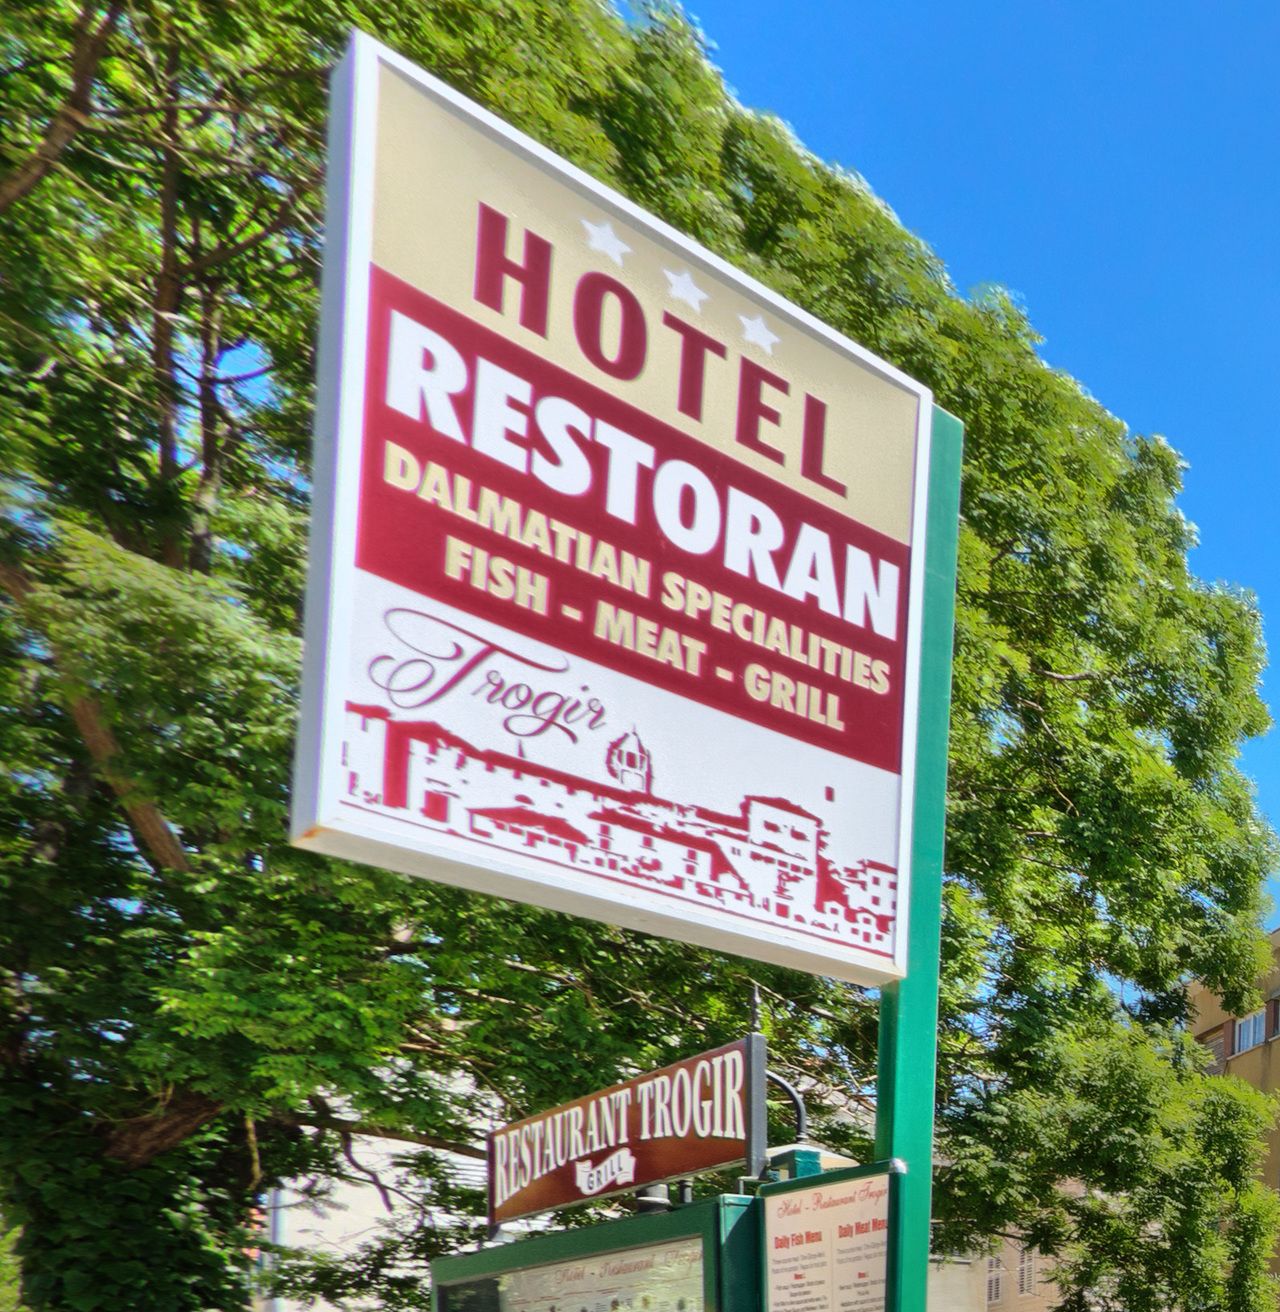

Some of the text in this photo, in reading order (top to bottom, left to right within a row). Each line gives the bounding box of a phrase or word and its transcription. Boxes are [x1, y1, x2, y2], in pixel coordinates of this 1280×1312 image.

[473, 201, 847, 498] HOTEL
[383, 440, 890, 695] DALMATIAN SPECIALITIES
[385, 309, 898, 639] RESTORAN
[368, 607, 608, 744] Trogir
[444, 535, 548, 617] FISH
[594, 600, 706, 680] MEAT
[745, 663, 844, 730] GRILL
[494, 1049, 747, 1209] RESTAURANT TROGIR
[586, 1159, 623, 1191] GRILL
